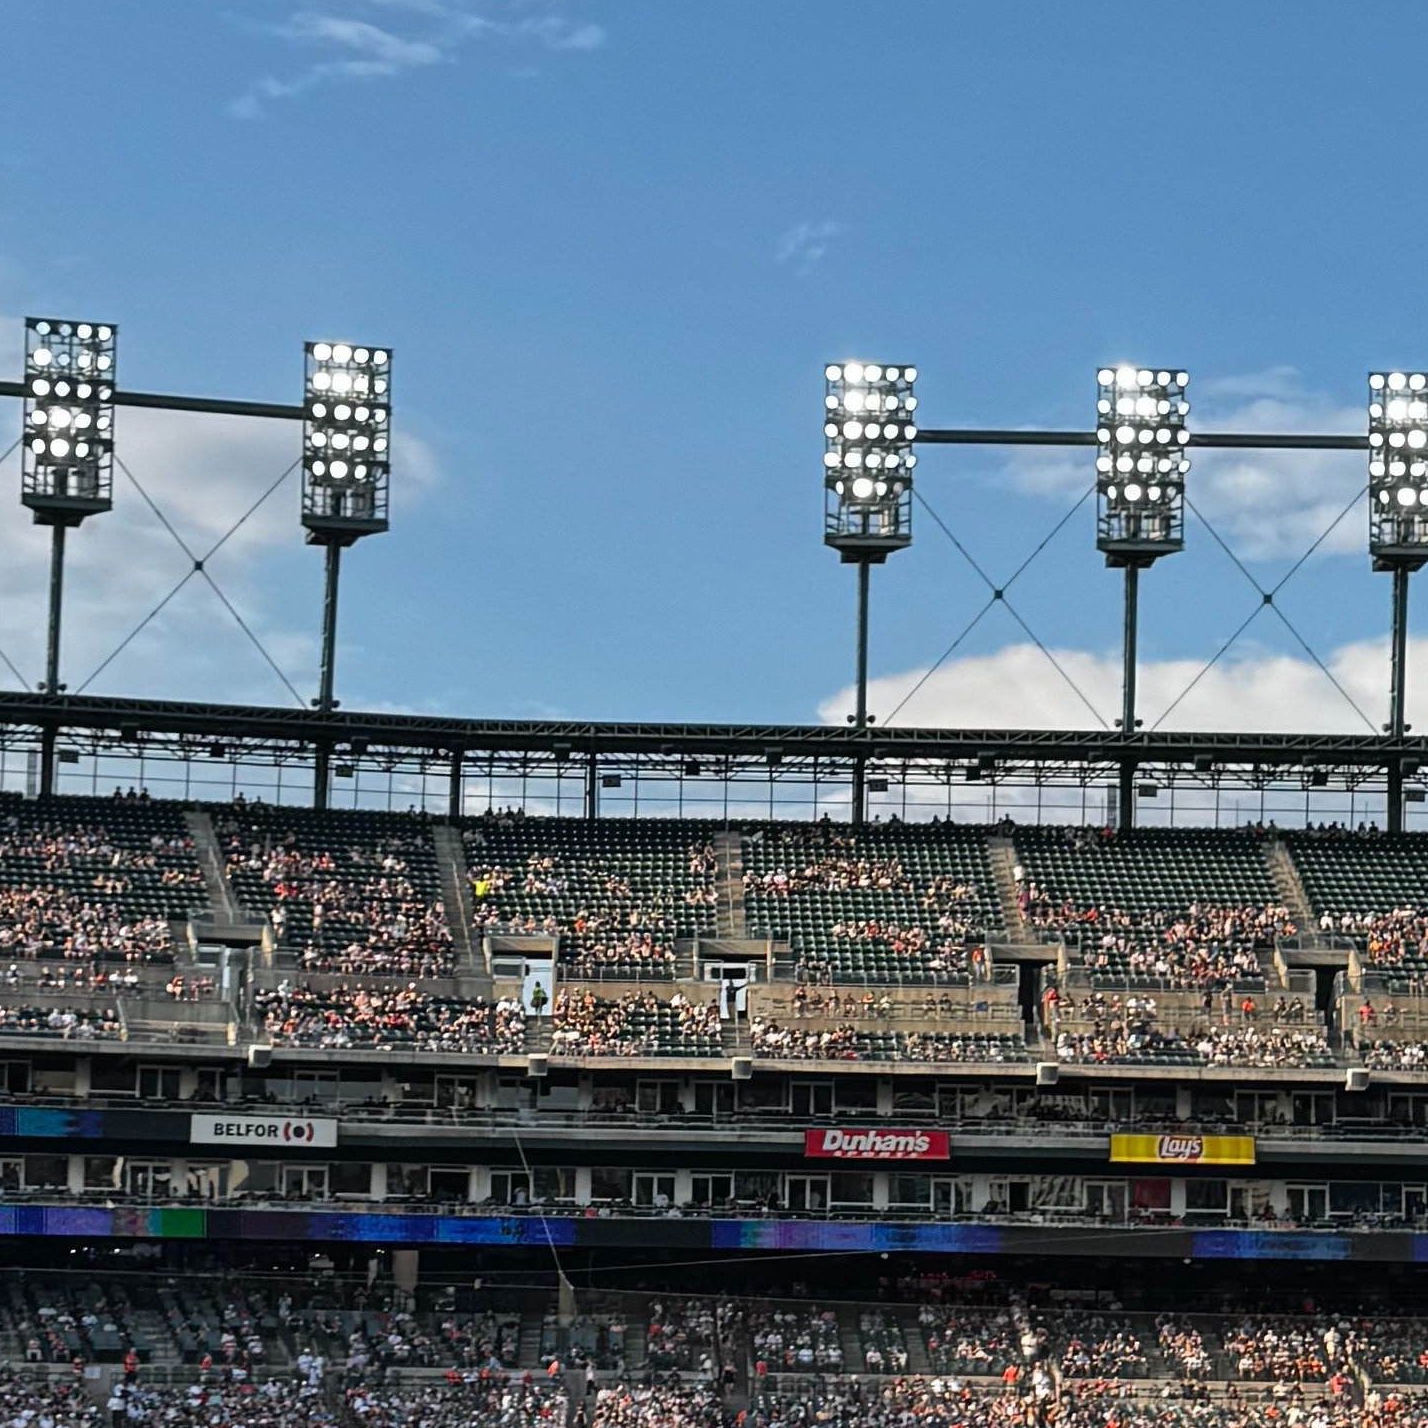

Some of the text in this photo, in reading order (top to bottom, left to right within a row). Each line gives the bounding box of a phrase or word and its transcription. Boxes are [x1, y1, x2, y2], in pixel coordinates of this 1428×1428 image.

[213, 1123, 278, 1137] BELFOR
[823, 1129, 930, 1152] Dunham's
[1161, 1136, 1201, 1159] Lay's
